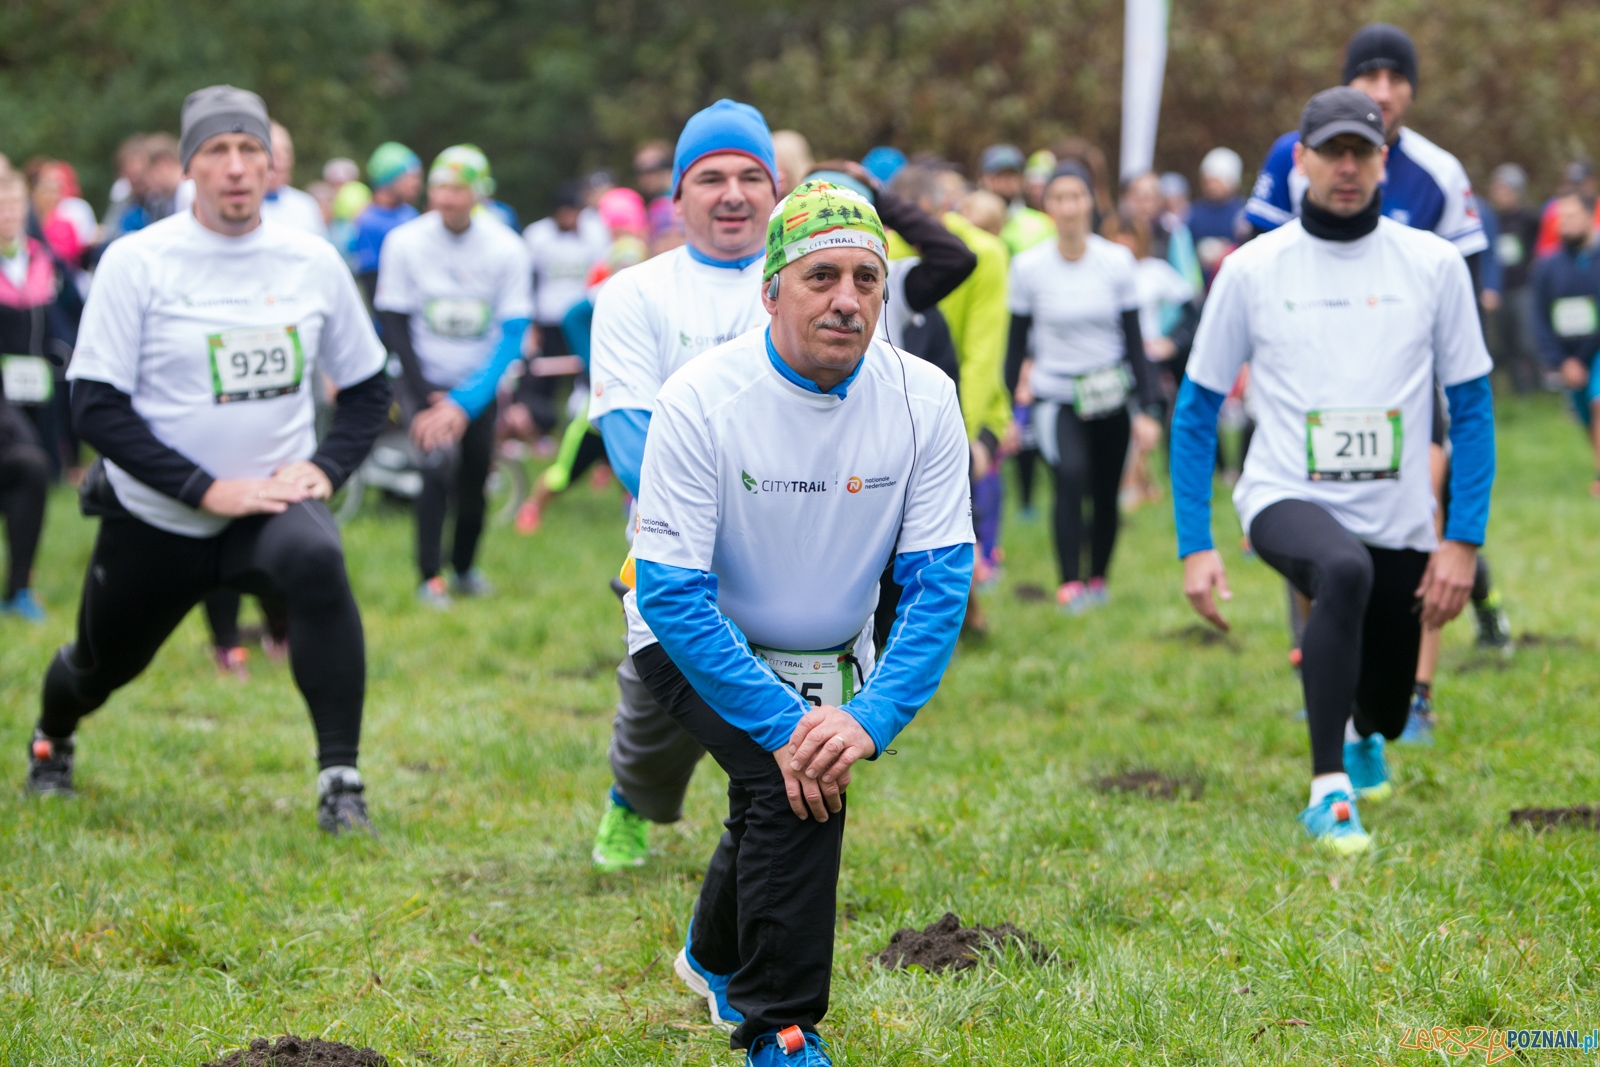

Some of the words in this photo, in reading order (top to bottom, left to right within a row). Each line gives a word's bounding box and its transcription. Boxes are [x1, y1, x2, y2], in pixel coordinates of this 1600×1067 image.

[230, 347, 286, 378] 929
[1334, 431, 1378, 457] 211
[865, 476, 890, 484] nationale
[865, 481, 897, 490] nederlanden
[642, 518, 669, 528] nationale
[641, 525, 680, 537] nederlanden
[785, 681, 823, 708] 5
